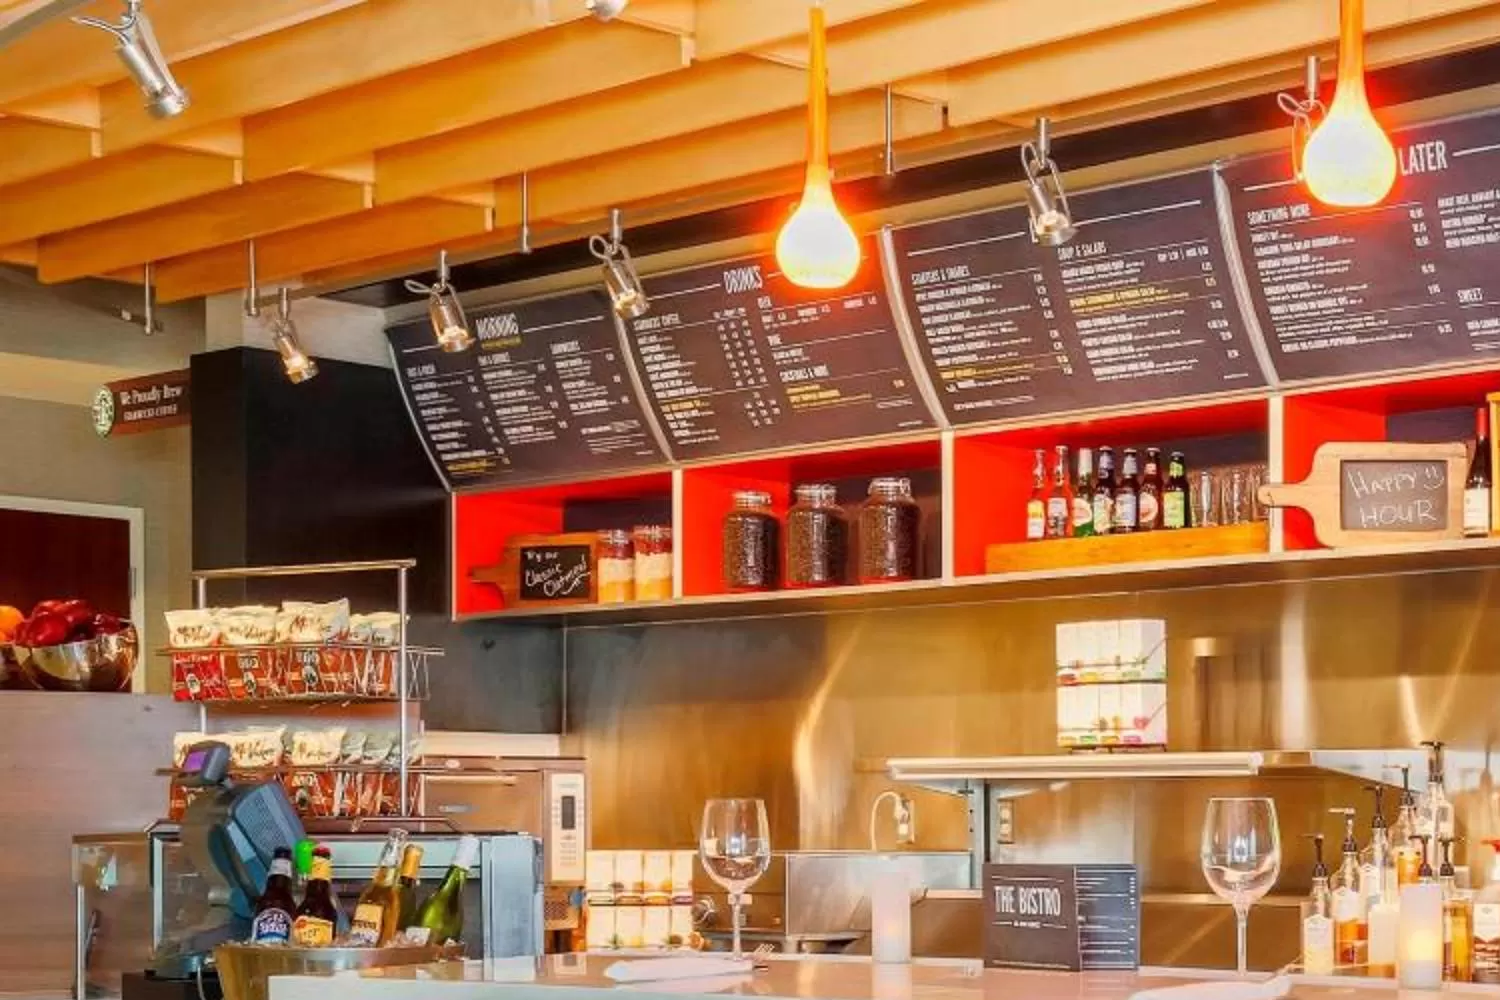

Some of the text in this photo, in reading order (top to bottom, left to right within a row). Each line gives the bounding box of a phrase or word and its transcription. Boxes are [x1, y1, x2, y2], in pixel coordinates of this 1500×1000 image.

[1400, 140, 1448, 176] LATER
[723, 265, 763, 294] DRINKS
[1359, 499, 1437, 529] HOUR
[994, 885, 1062, 917] THE BISTRO
